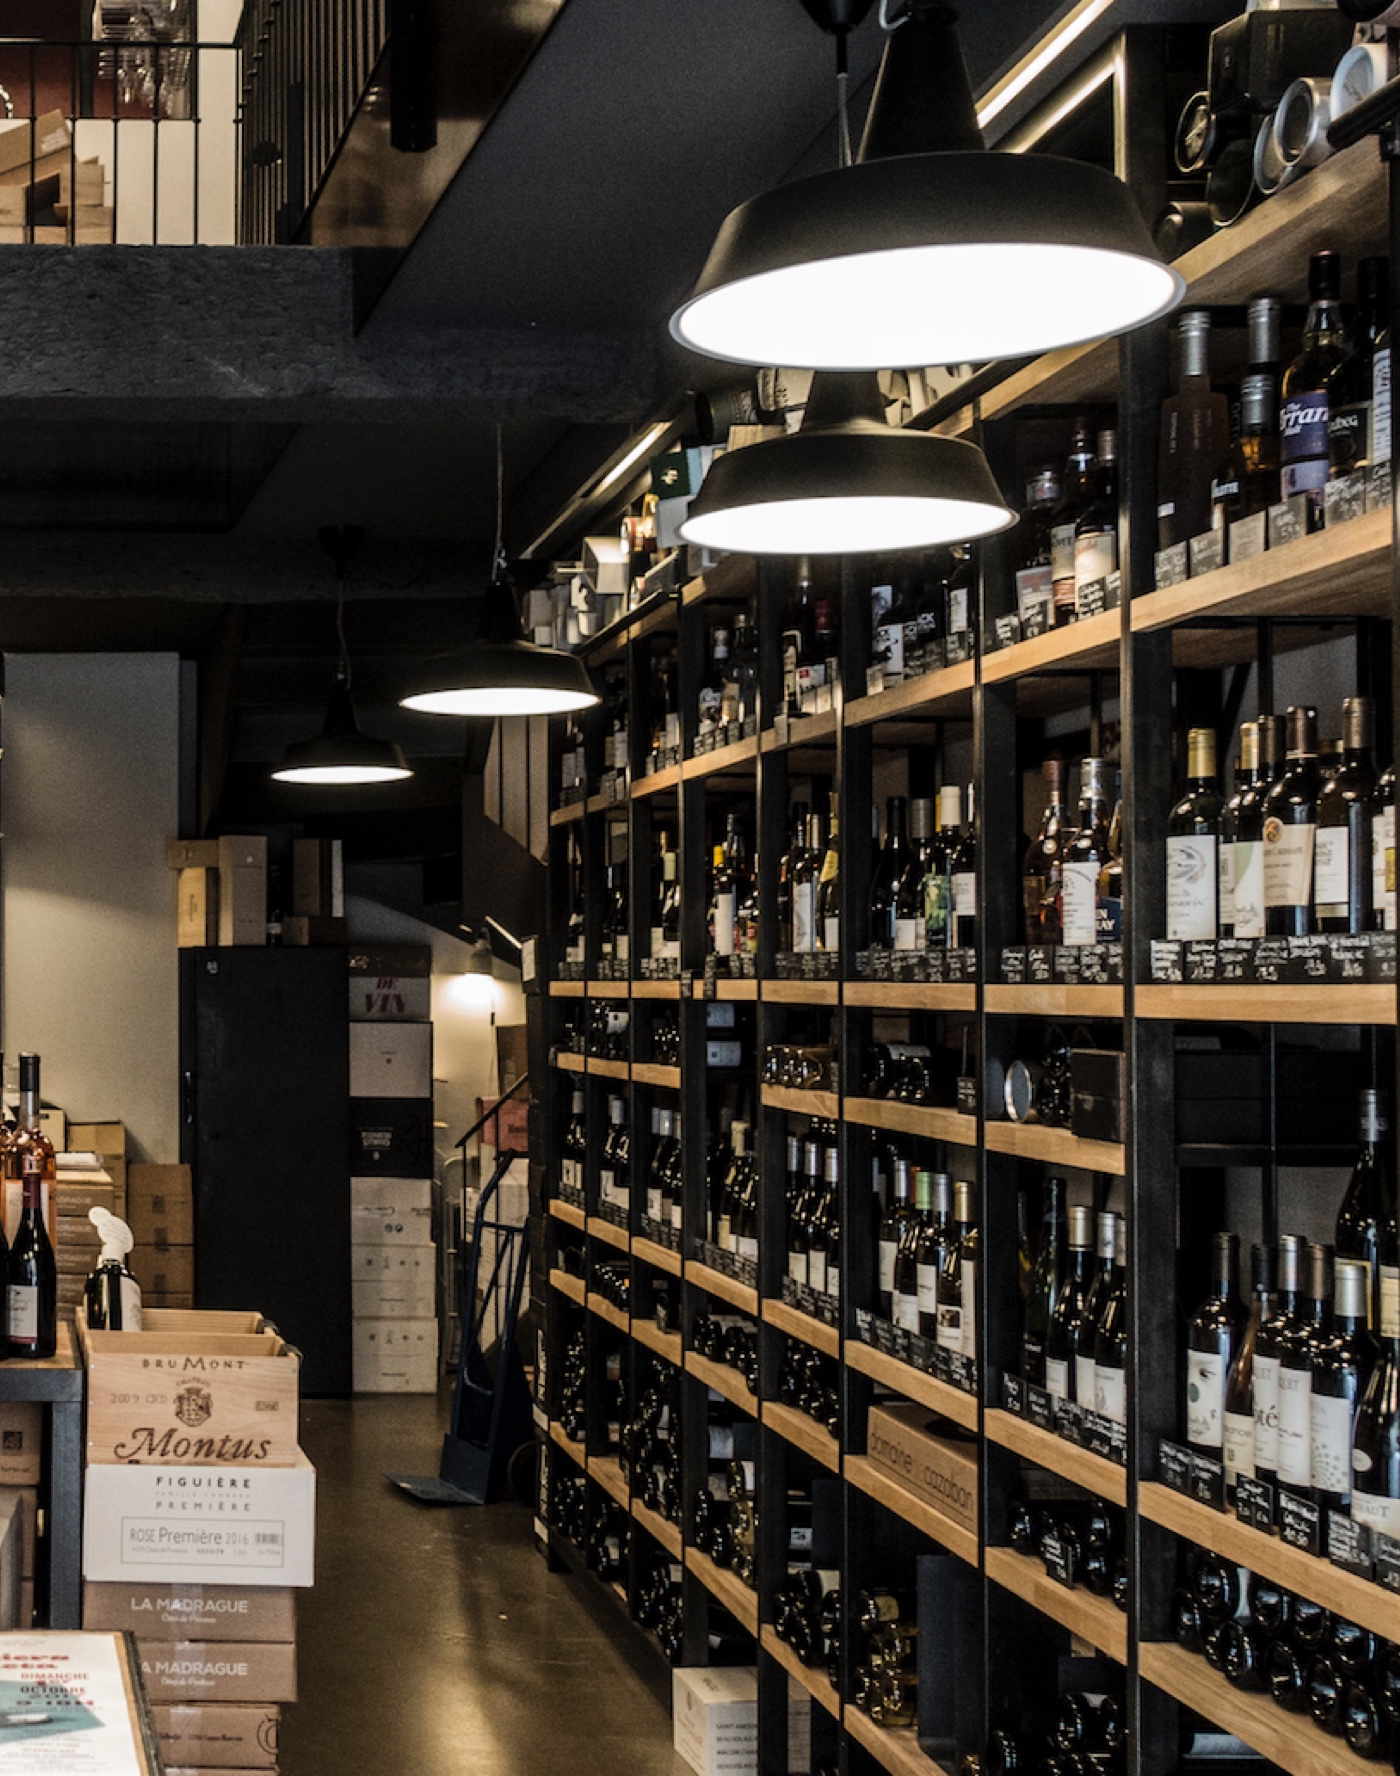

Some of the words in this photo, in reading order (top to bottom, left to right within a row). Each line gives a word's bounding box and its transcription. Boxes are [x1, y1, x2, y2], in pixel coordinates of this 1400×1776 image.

[363, 992, 406, 1013] VIN
[142, 1356, 246, 1371] BRUMONT
[114, 1427, 272, 1460] Montus
[155, 1475, 251, 1489] FIGUIÈRE
[155, 1500, 251, 1512] PREMIÈRE
[158, 1525, 222, 1545] Première
[131, 1597, 153, 1611] LA
[156, 1598, 249, 1613] MADRAGUE
[155, 1661, 248, 1676] MADRAGUE
